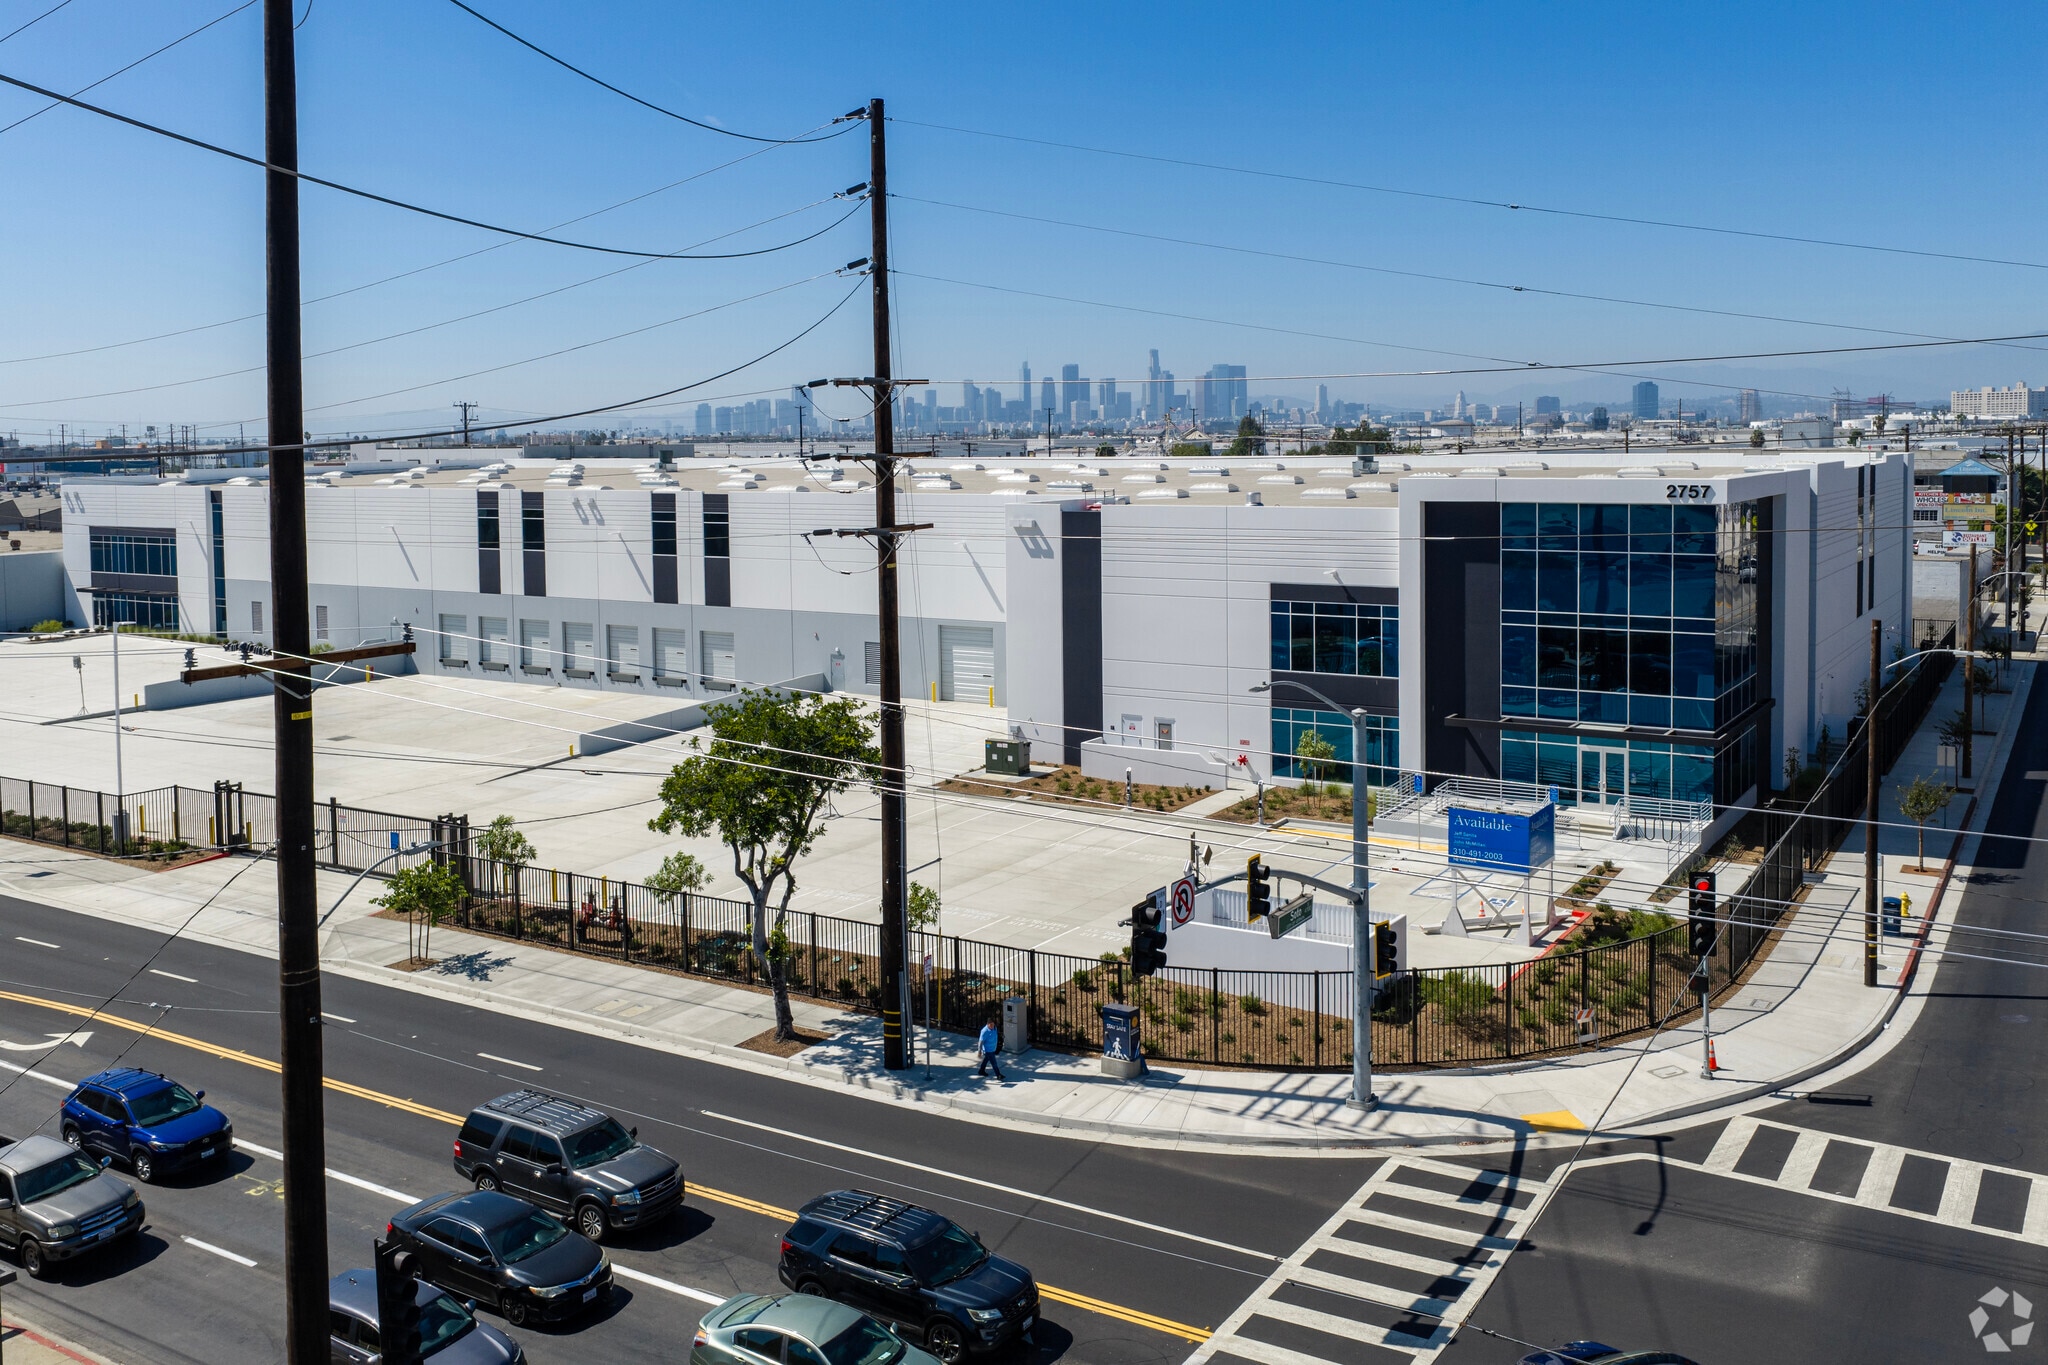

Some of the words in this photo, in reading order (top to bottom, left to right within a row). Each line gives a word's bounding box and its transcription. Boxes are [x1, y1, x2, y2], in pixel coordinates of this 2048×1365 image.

[1666, 484, 1711, 499] 2757
[1454, 814, 1512, 832] Available
[1453, 848, 1503, 861] 310-491-2003
[1290, 908, 1303, 921] Soto
